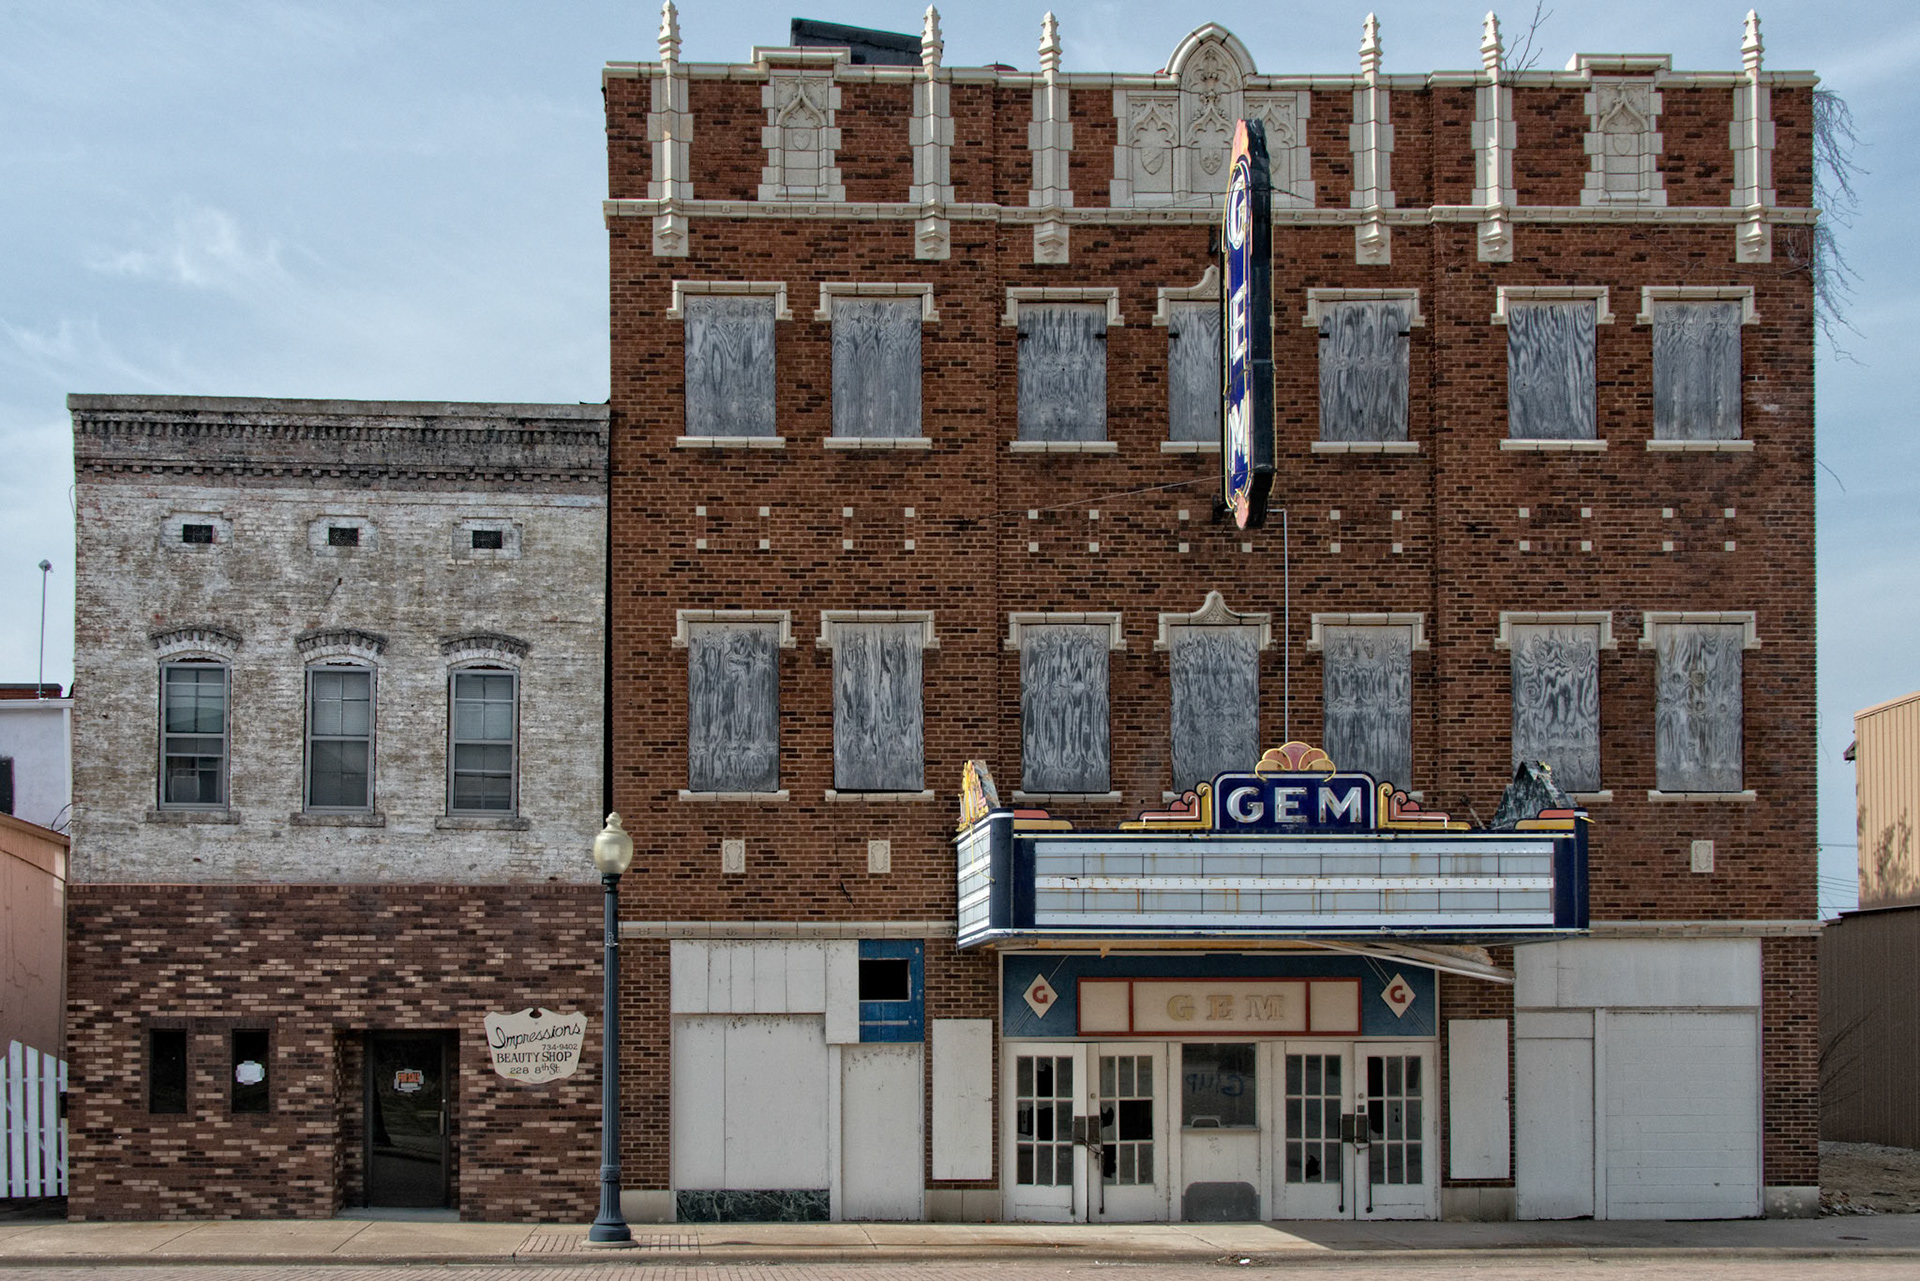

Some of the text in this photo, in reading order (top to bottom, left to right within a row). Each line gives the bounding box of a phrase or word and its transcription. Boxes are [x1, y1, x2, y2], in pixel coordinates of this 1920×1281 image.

[1227, 172, 1250, 477] GEM
[1226, 786, 1362, 824] GEM
[1031, 985, 1049, 1005] G
[1389, 983, 1407, 1005] G
[1167, 993, 1286, 1022] GEM
[491, 1023, 582, 1050] Impressions
[542, 1043, 578, 1051] 734-9402
[496, 1050, 573, 1063] BEAUTY SHOP
[509, 1066, 530, 1075] 228
